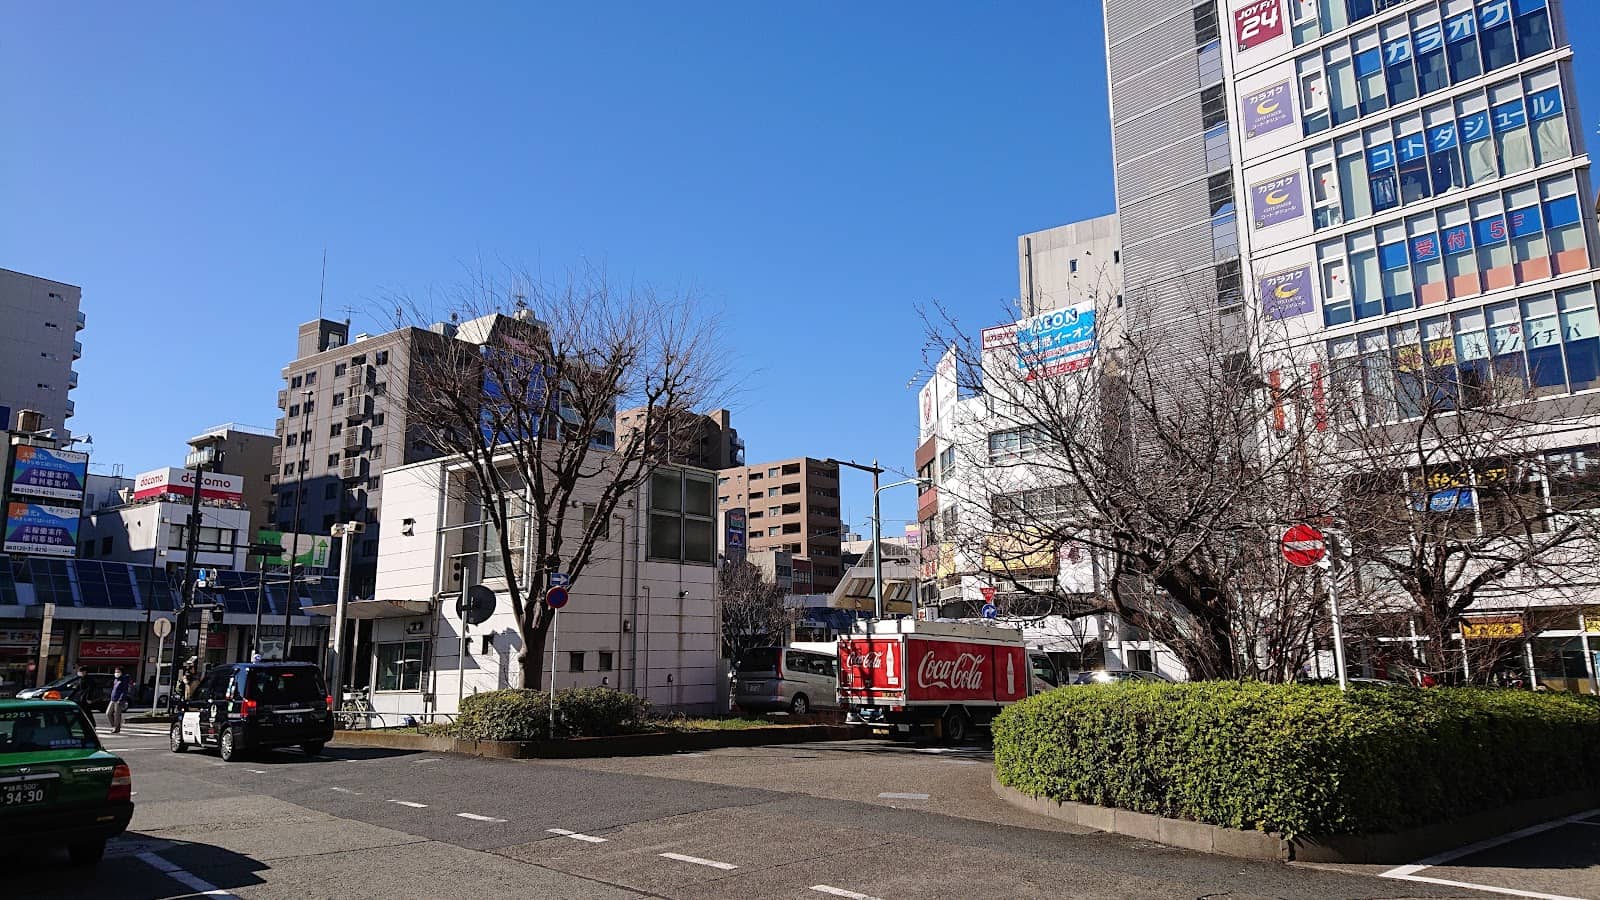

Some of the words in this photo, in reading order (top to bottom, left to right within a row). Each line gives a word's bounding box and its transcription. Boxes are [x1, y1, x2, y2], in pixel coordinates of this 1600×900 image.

[1241, 6, 1279, 40] 24
[1387, 1, 1508, 62] カラオケ
[1258, 177, 1294, 194] カラオケ
[1415, 229, 1467, 259] 受付
[1031, 307, 1079, 334] AEON
[140, 473, 164, 487] docomo
[181, 472, 231, 488] doomo
[6, 711, 31, 719] 2251
[6, 790, 44, 804] 94-90
